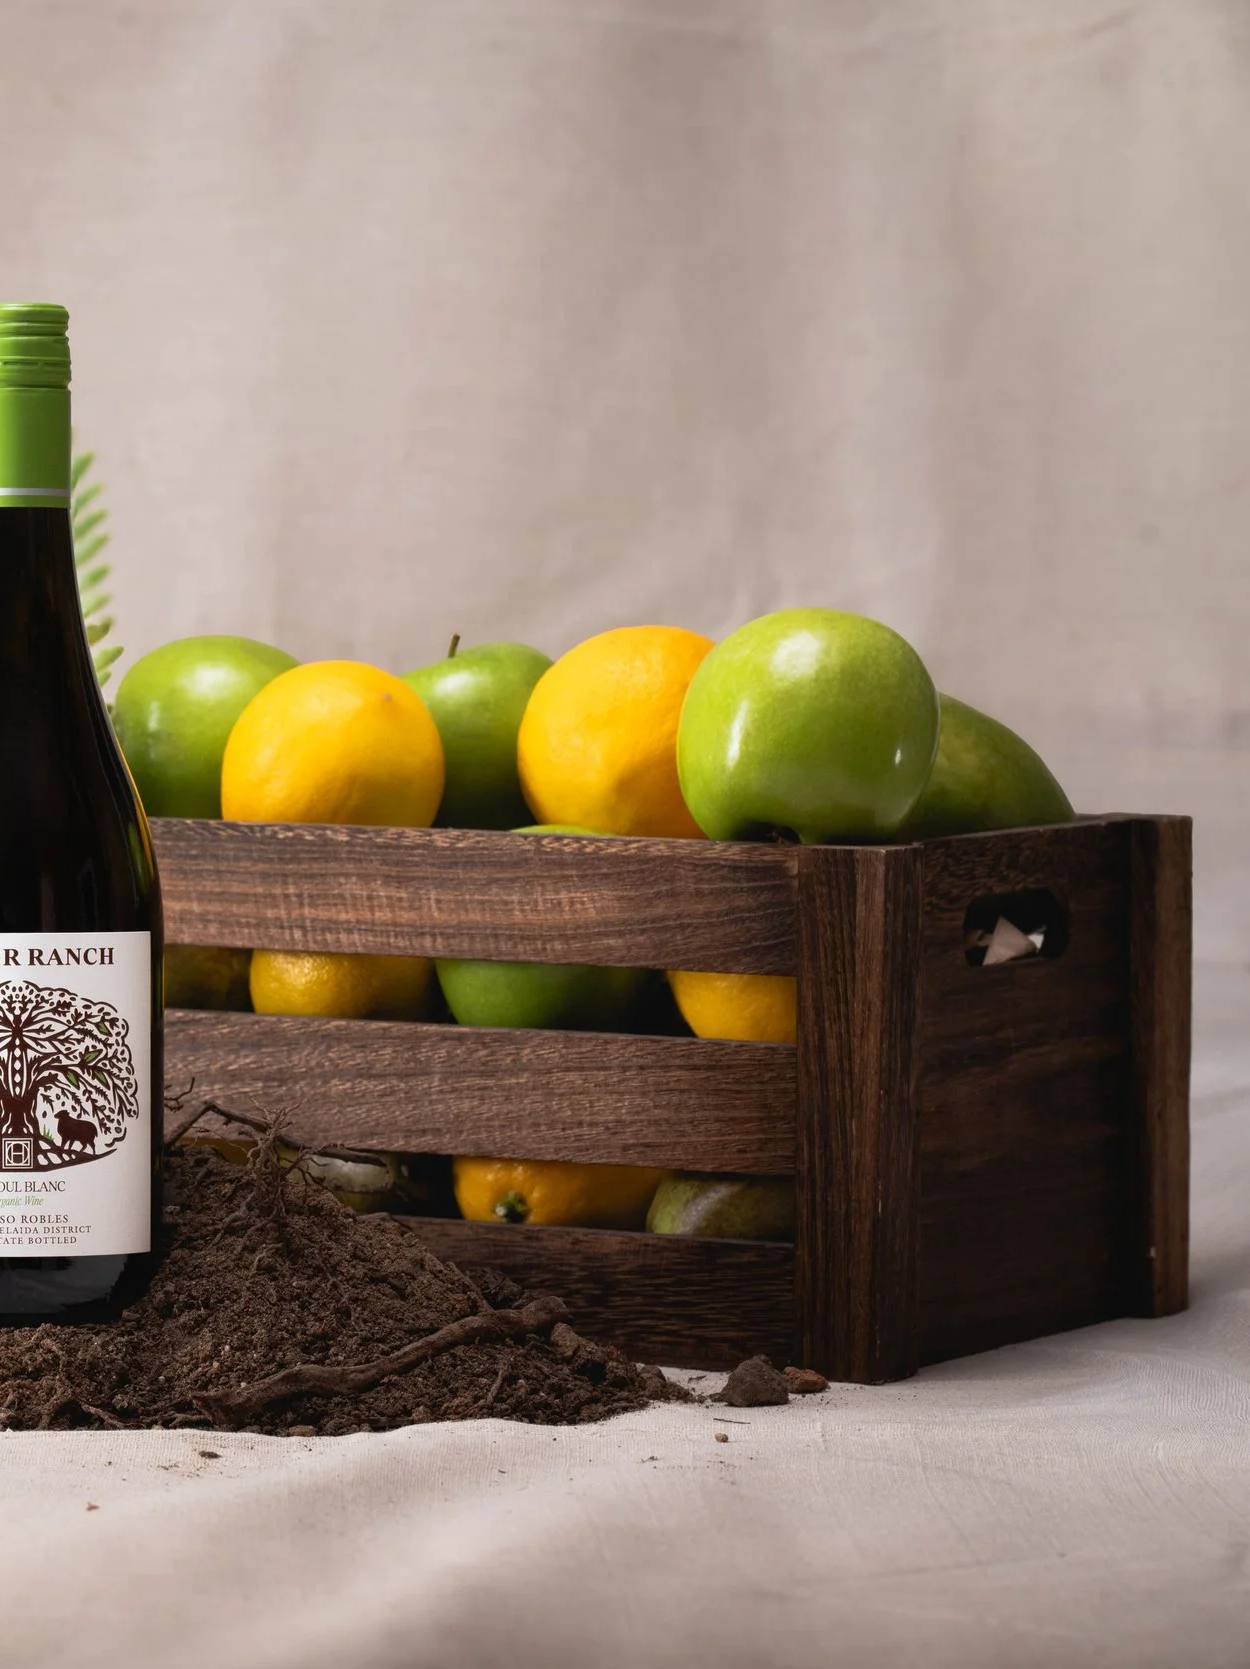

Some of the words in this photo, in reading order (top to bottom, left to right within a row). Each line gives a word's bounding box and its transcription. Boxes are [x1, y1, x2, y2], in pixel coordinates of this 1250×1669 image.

[27, 947, 115, 966] RANCH
[24, 1180, 66, 1193] BLANC
[24, 1195, 44, 1206] Wine
[21, 1214, 69, 1224] ROBLES
[43, 1225, 92, 1234] DISTRICT
[28, 1236, 77, 1244] BOTTLED
